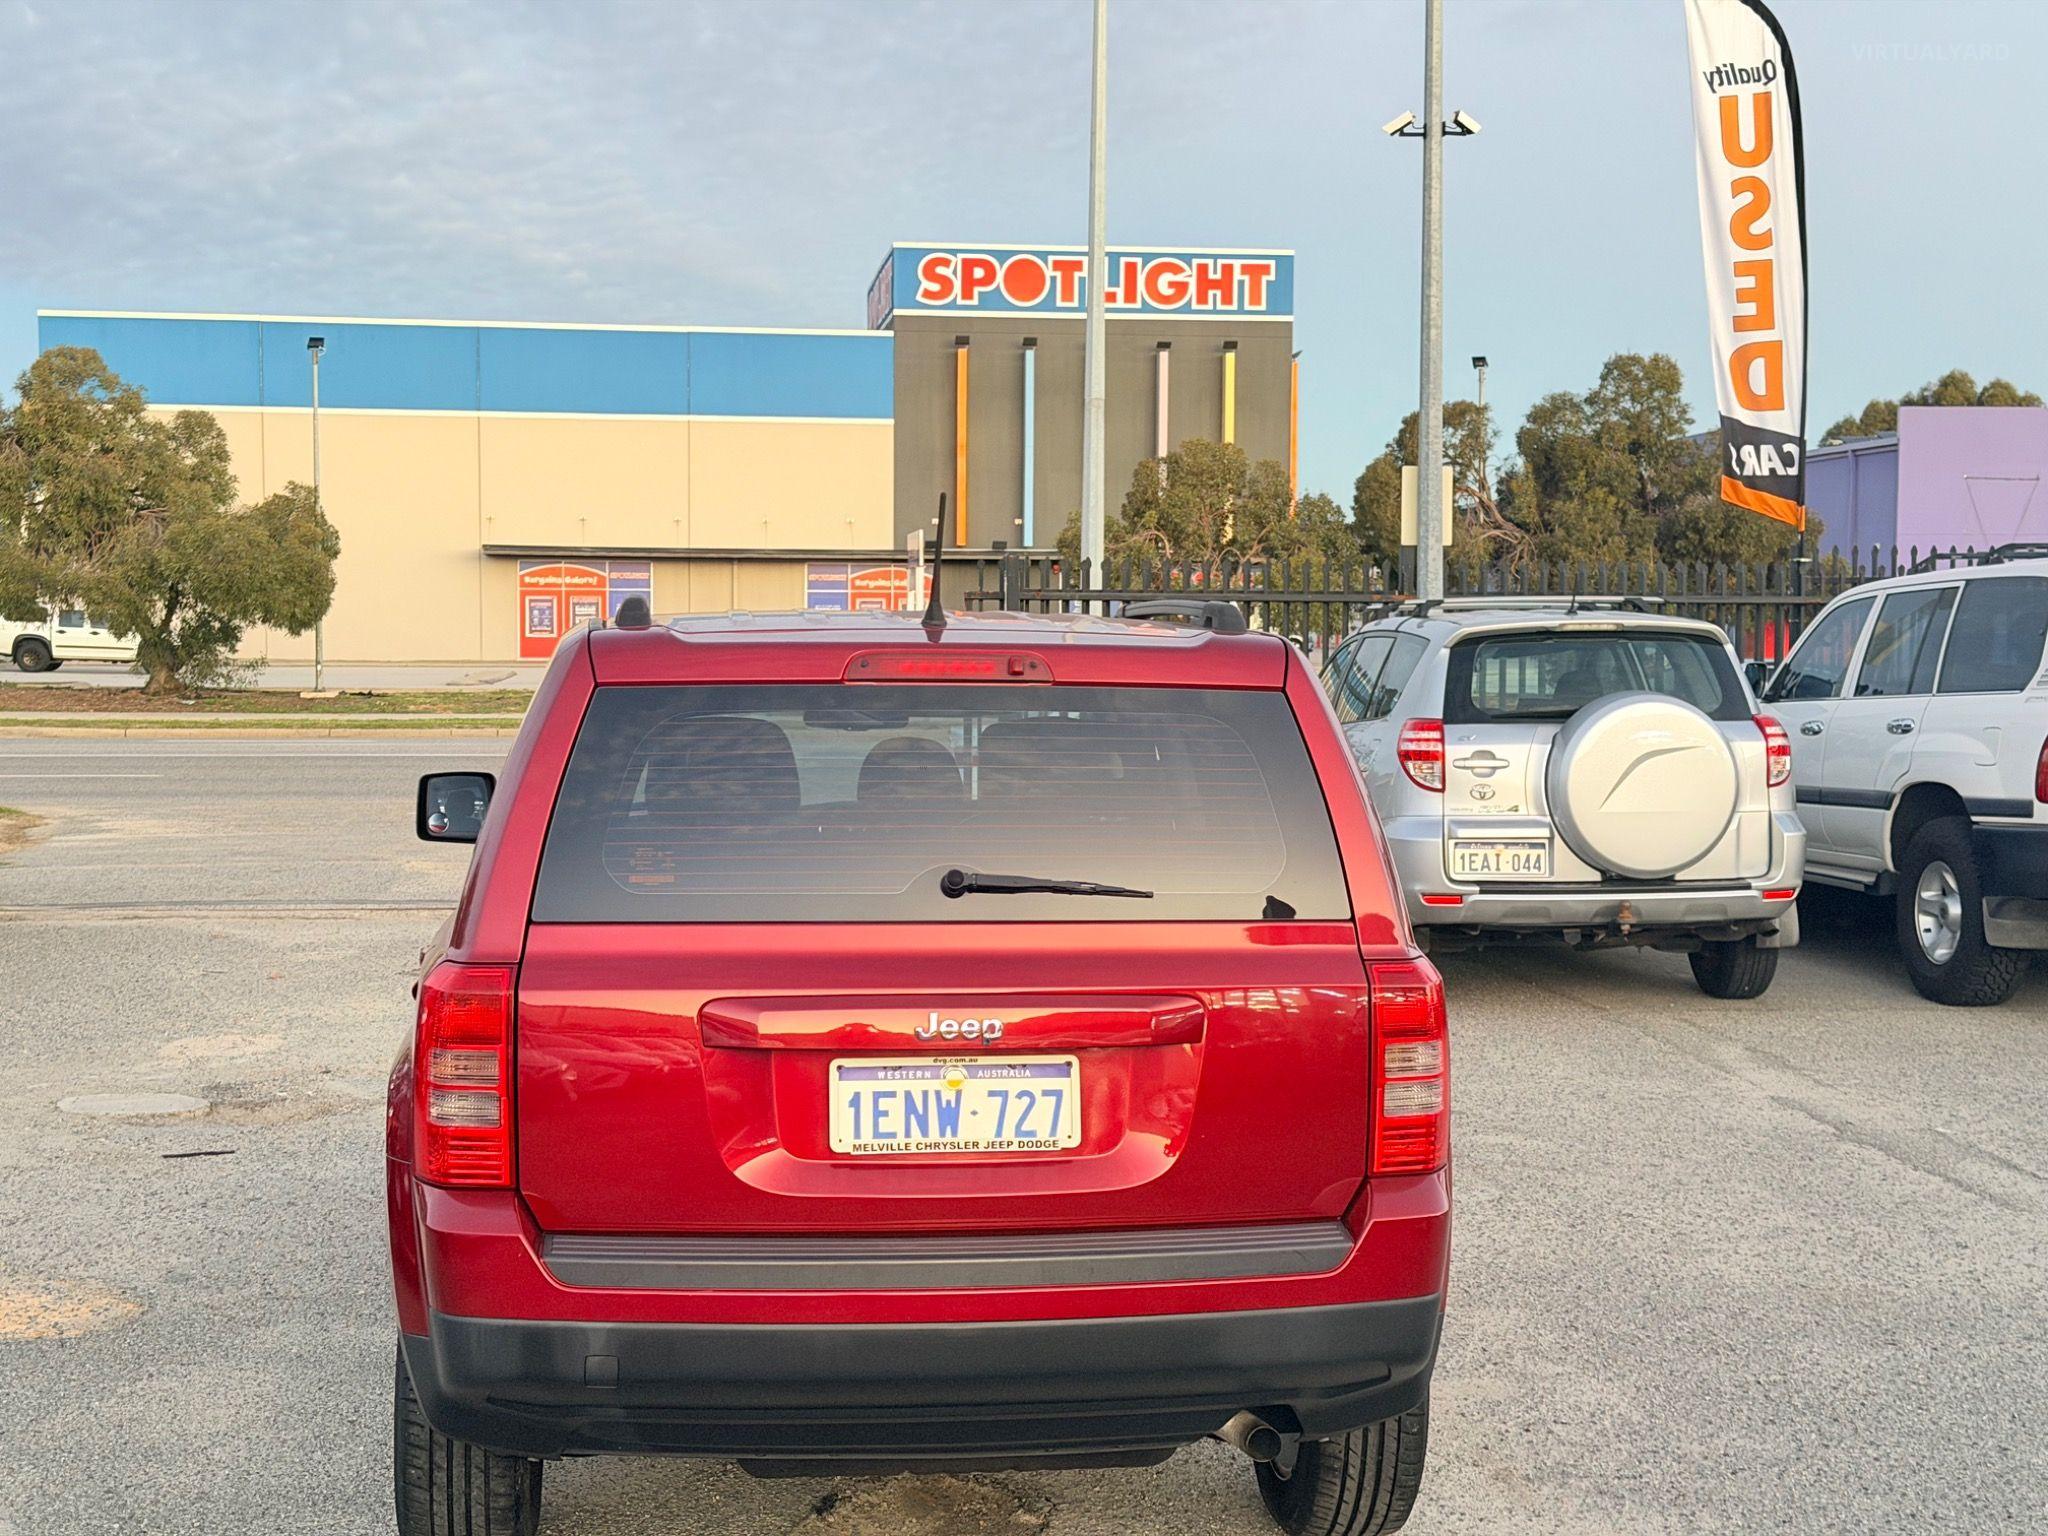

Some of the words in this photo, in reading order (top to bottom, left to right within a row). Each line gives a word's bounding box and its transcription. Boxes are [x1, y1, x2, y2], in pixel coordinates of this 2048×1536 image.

[914, 1012, 1004, 1045] Jeep
[877, 1070, 932, 1080] WESTERN
[977, 1069, 1031, 1078] AUSTRALIA
[852, 1143, 912, 1152] MELVILLE
[915, 1142, 980, 1151] CHRYSLER
[983, 1140, 1014, 1150] JEEP
[1018, 1139, 1060, 1149] DODGE
